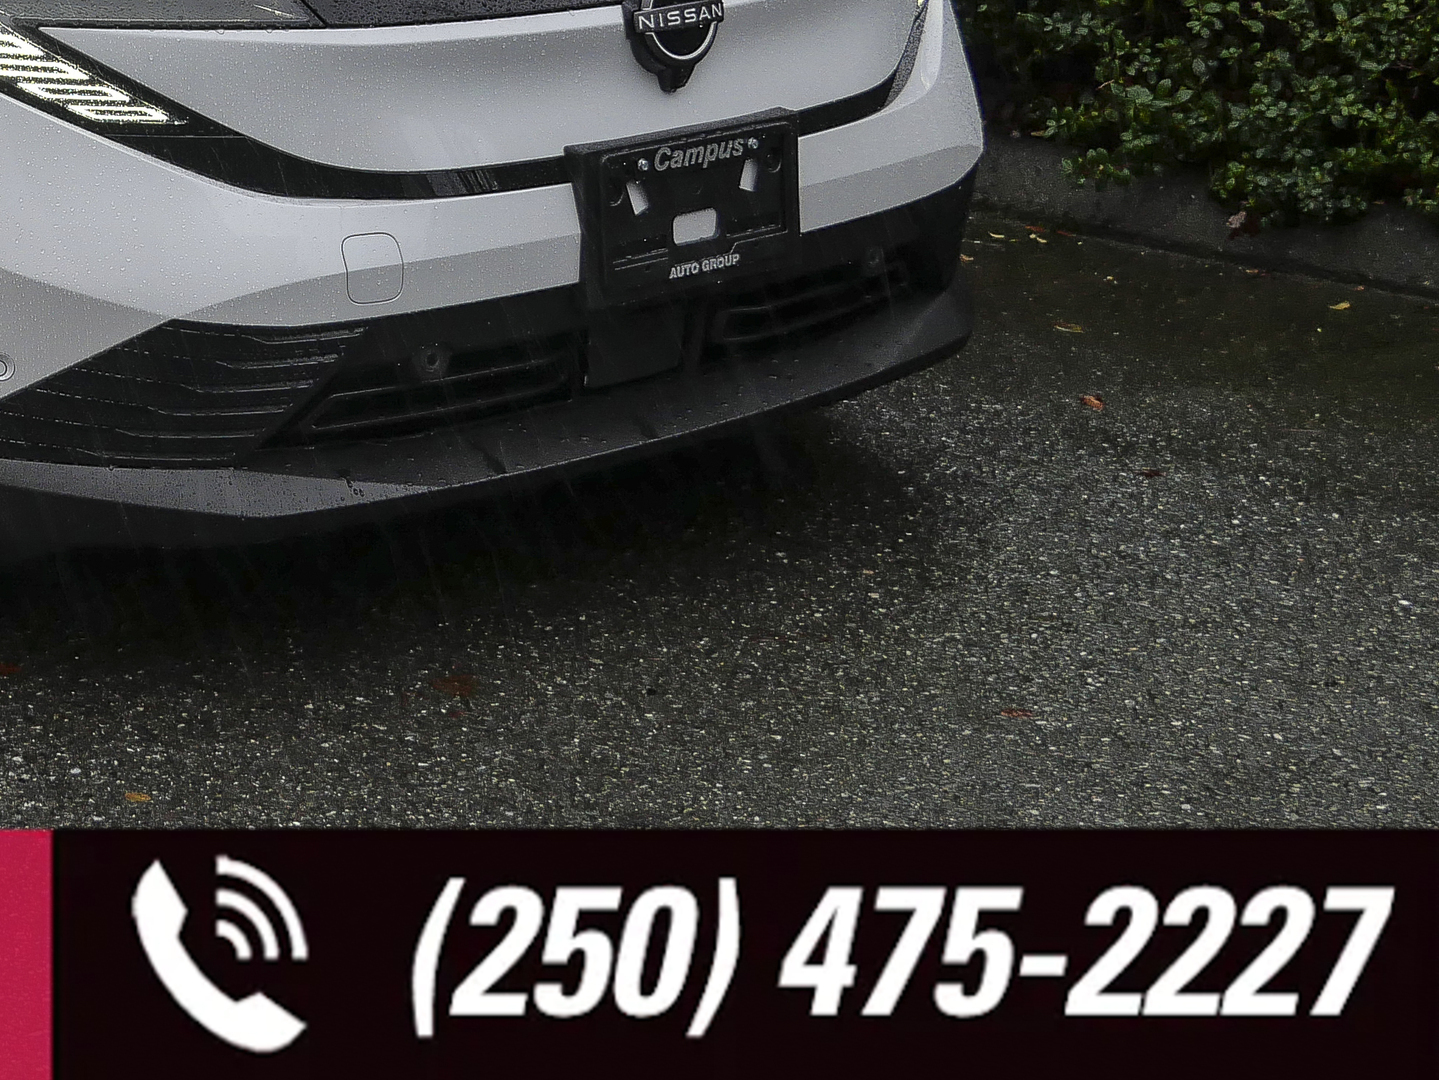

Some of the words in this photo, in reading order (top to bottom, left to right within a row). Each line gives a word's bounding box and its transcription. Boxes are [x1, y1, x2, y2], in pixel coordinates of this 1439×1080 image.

[638, 3, 723, 30] NISSAN
[653, 138, 744, 172] Campus
[668, 262, 700, 280] AUTO
[701, 253, 741, 272] GROUP
